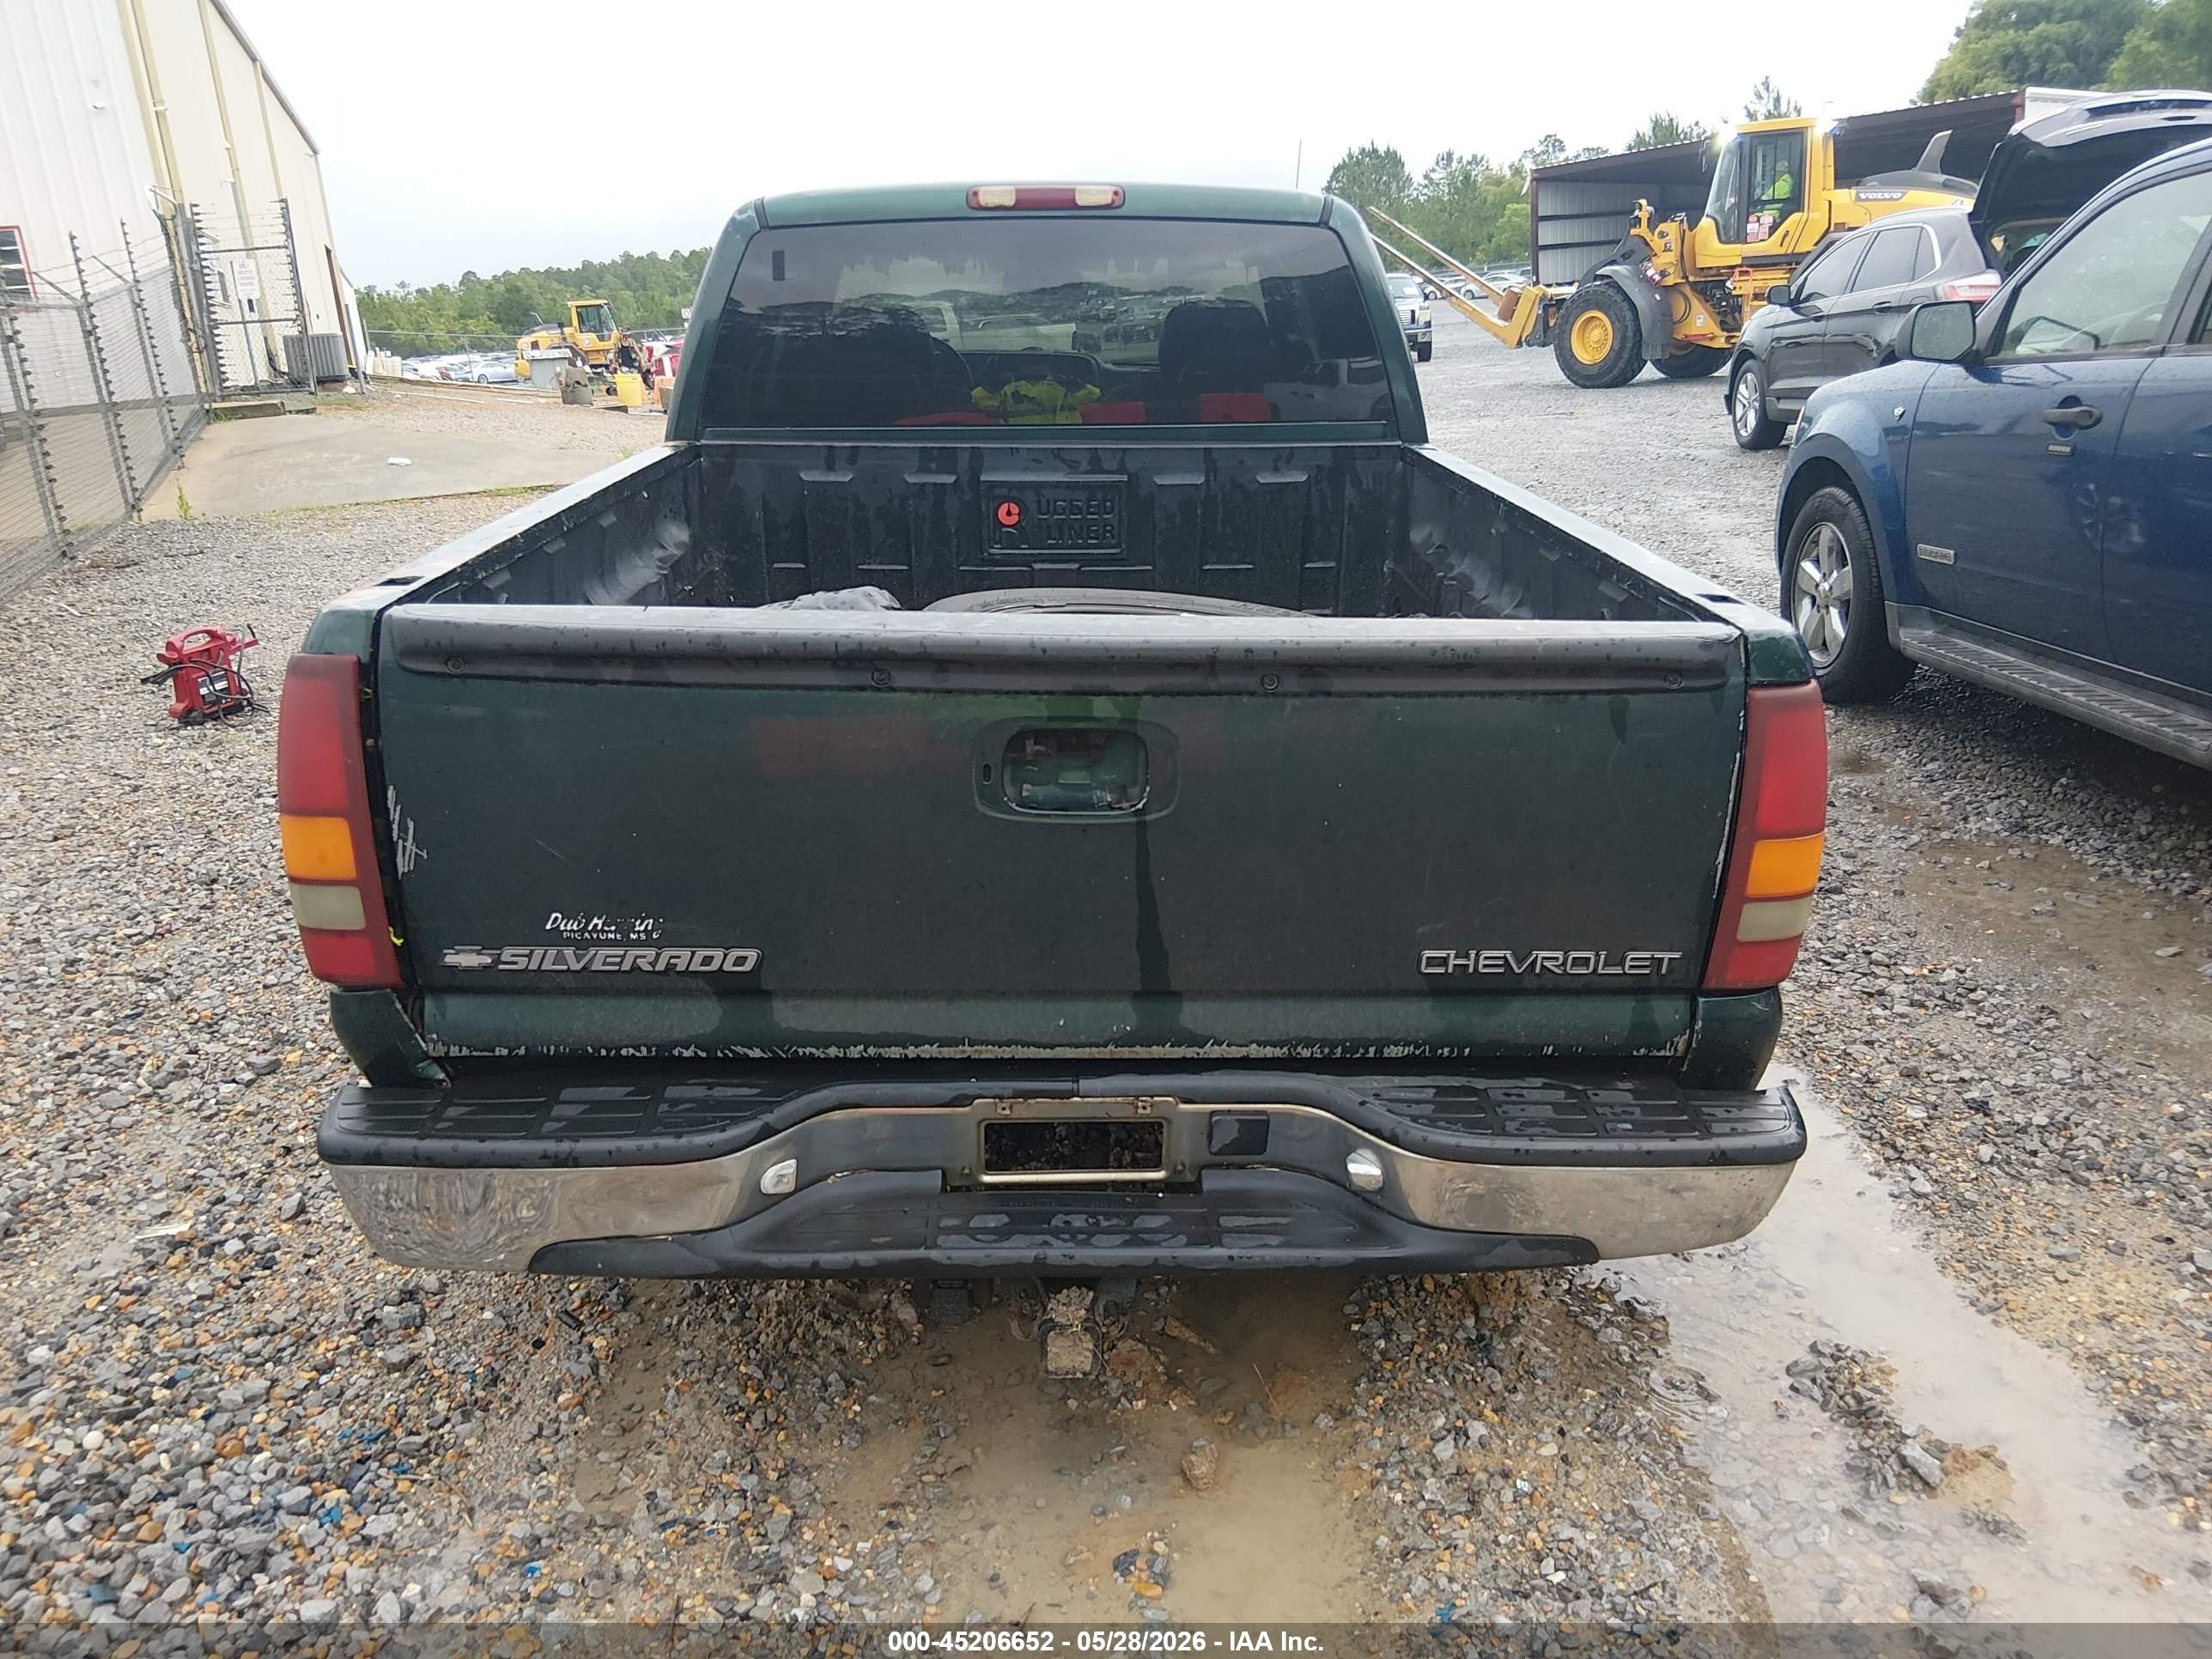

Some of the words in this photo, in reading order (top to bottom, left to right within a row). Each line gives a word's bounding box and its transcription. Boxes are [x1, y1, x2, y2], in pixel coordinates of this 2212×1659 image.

[1858, 191, 1902, 200] VOLVO
[1046, 526, 1116, 544] LINER
[629, 932, 647, 940] MS
[498, 947, 761, 972] SILVERADO
[1419, 950, 1683, 975] CHEVROLET
